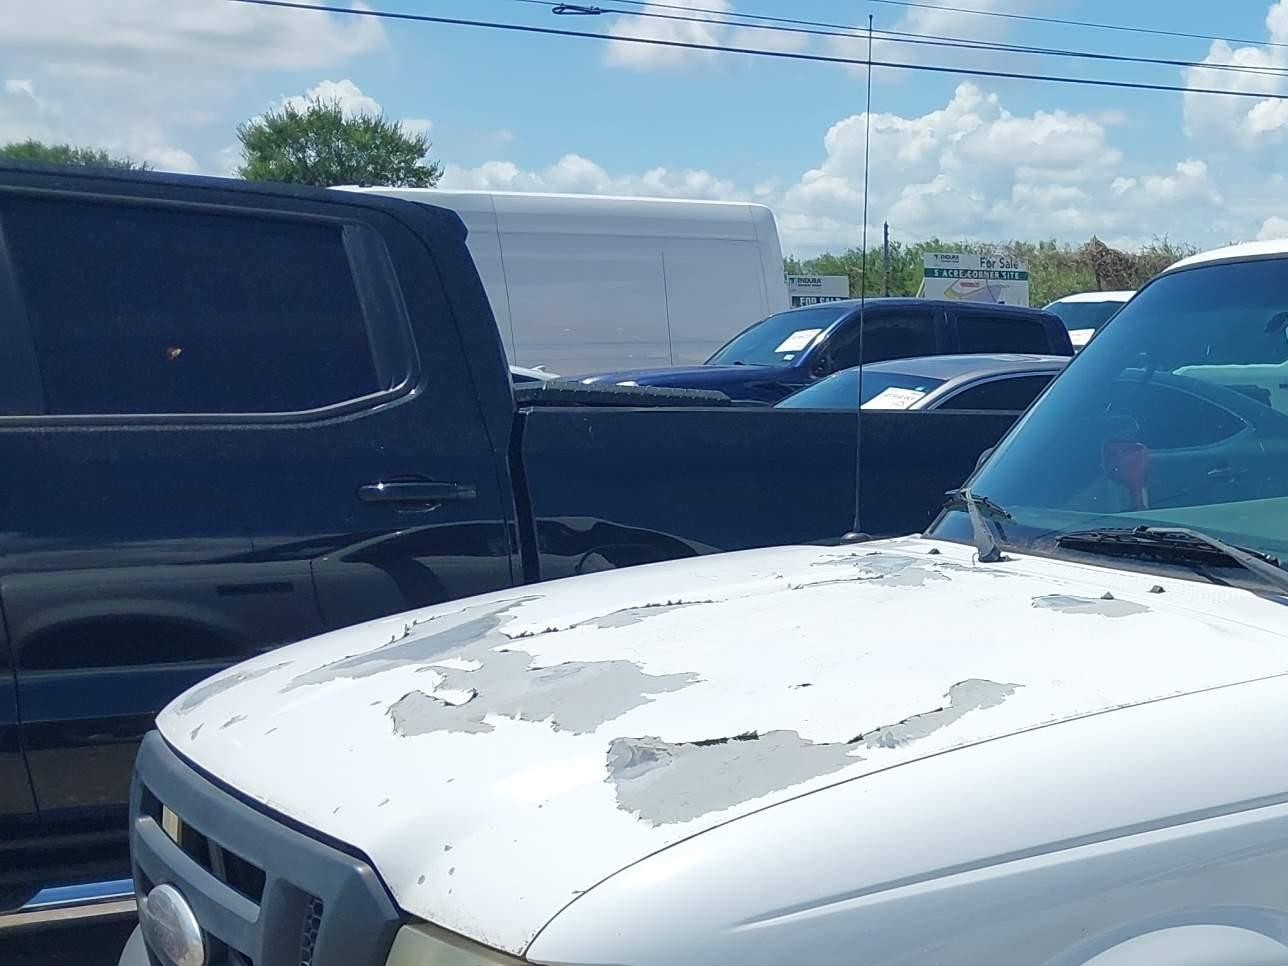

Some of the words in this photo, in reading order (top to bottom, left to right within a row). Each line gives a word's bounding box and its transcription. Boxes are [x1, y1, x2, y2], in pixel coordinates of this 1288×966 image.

[980, 257, 996, 269] For
[1000, 257, 1019, 270] Sale
[942, 269, 964, 278] ACRE
[966, 270, 1000, 279] CORNER
[1003, 271, 1020, 280] SITE
